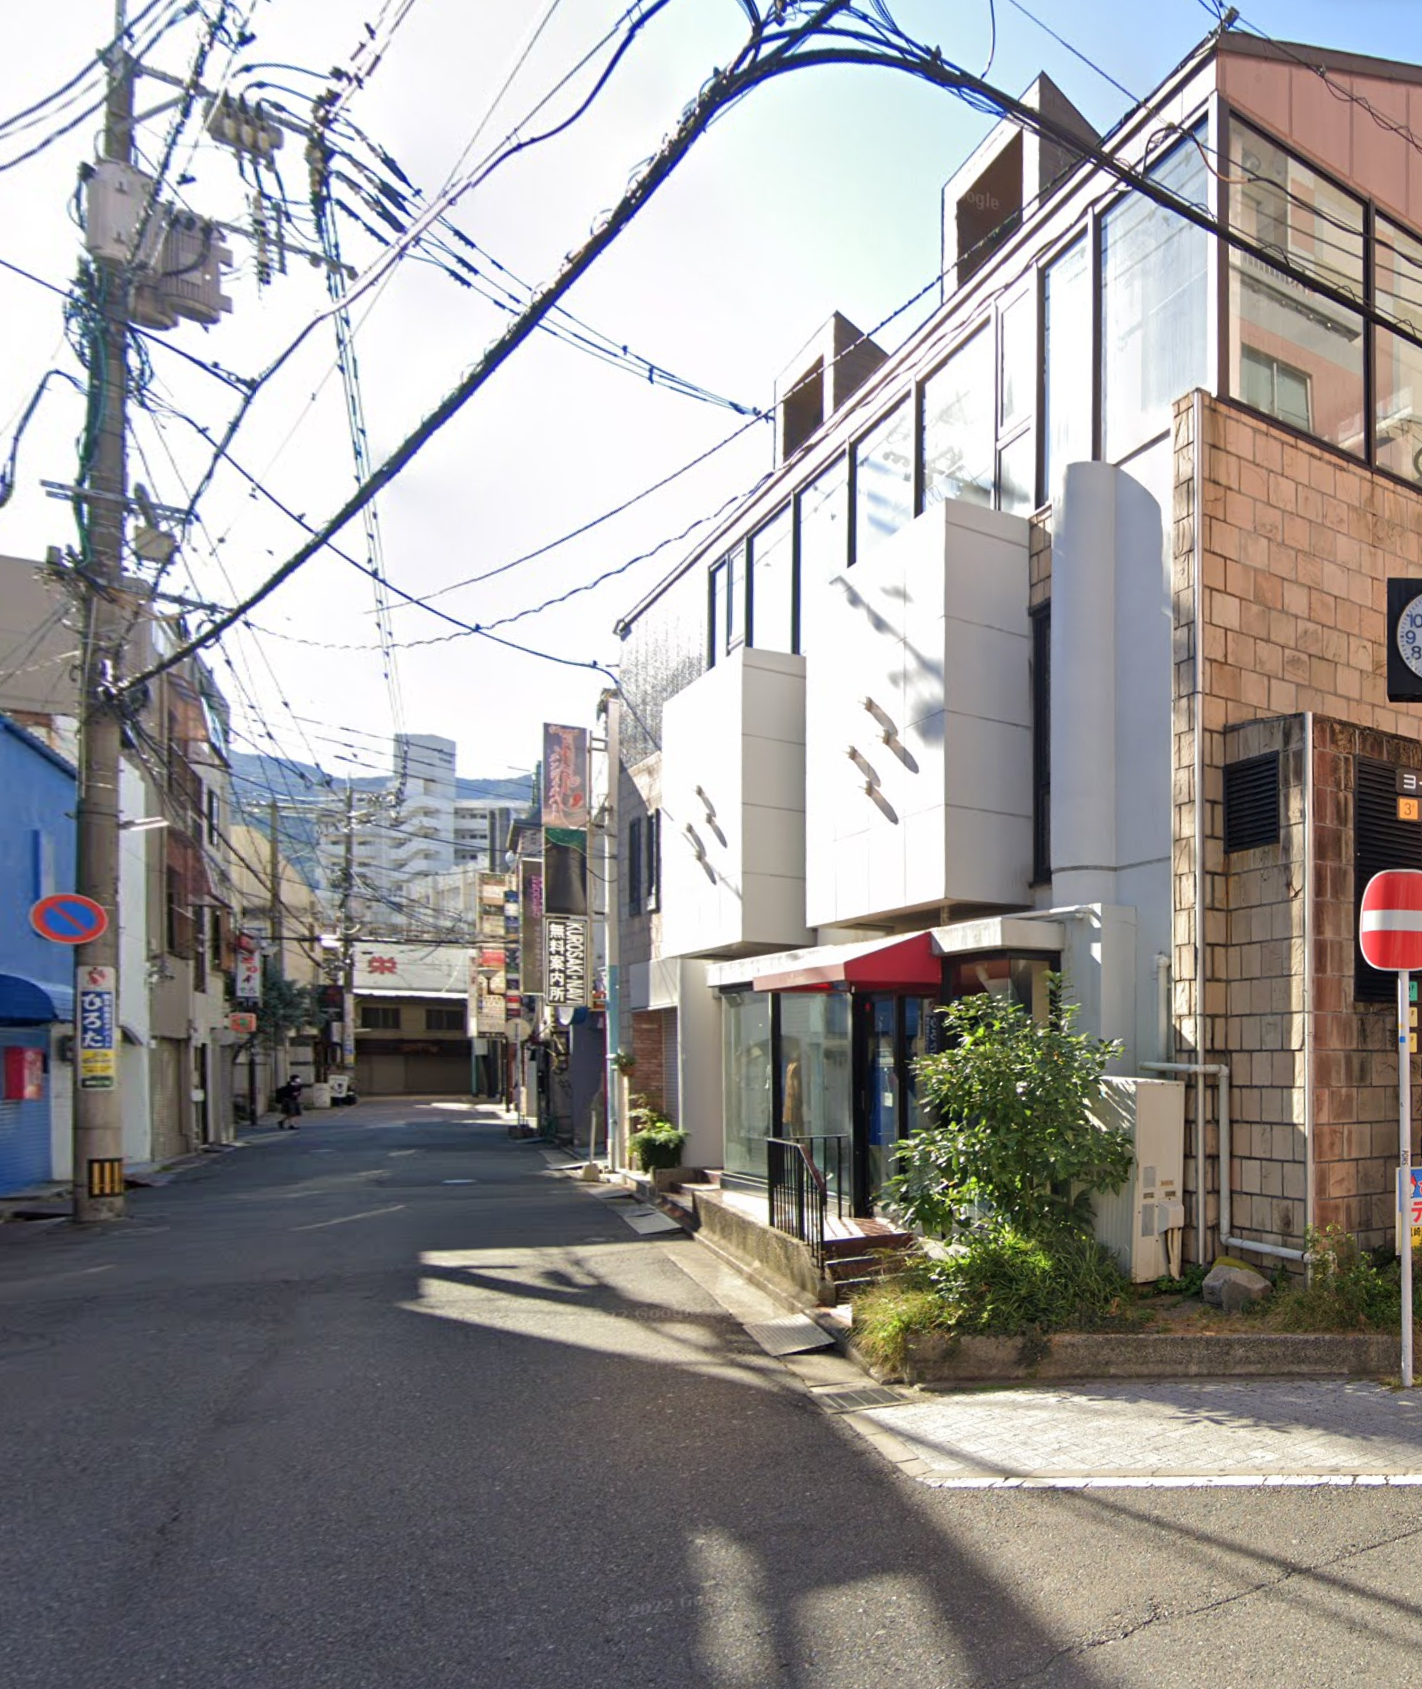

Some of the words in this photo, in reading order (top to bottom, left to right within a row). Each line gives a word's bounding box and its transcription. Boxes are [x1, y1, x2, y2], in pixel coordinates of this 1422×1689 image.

[1405, 630, 1416, 644] 9
[1411, 646, 1422, 660] 8
[549, 923, 565, 1002] 無料案内所
[83, 993, 104, 1047] ひろた
